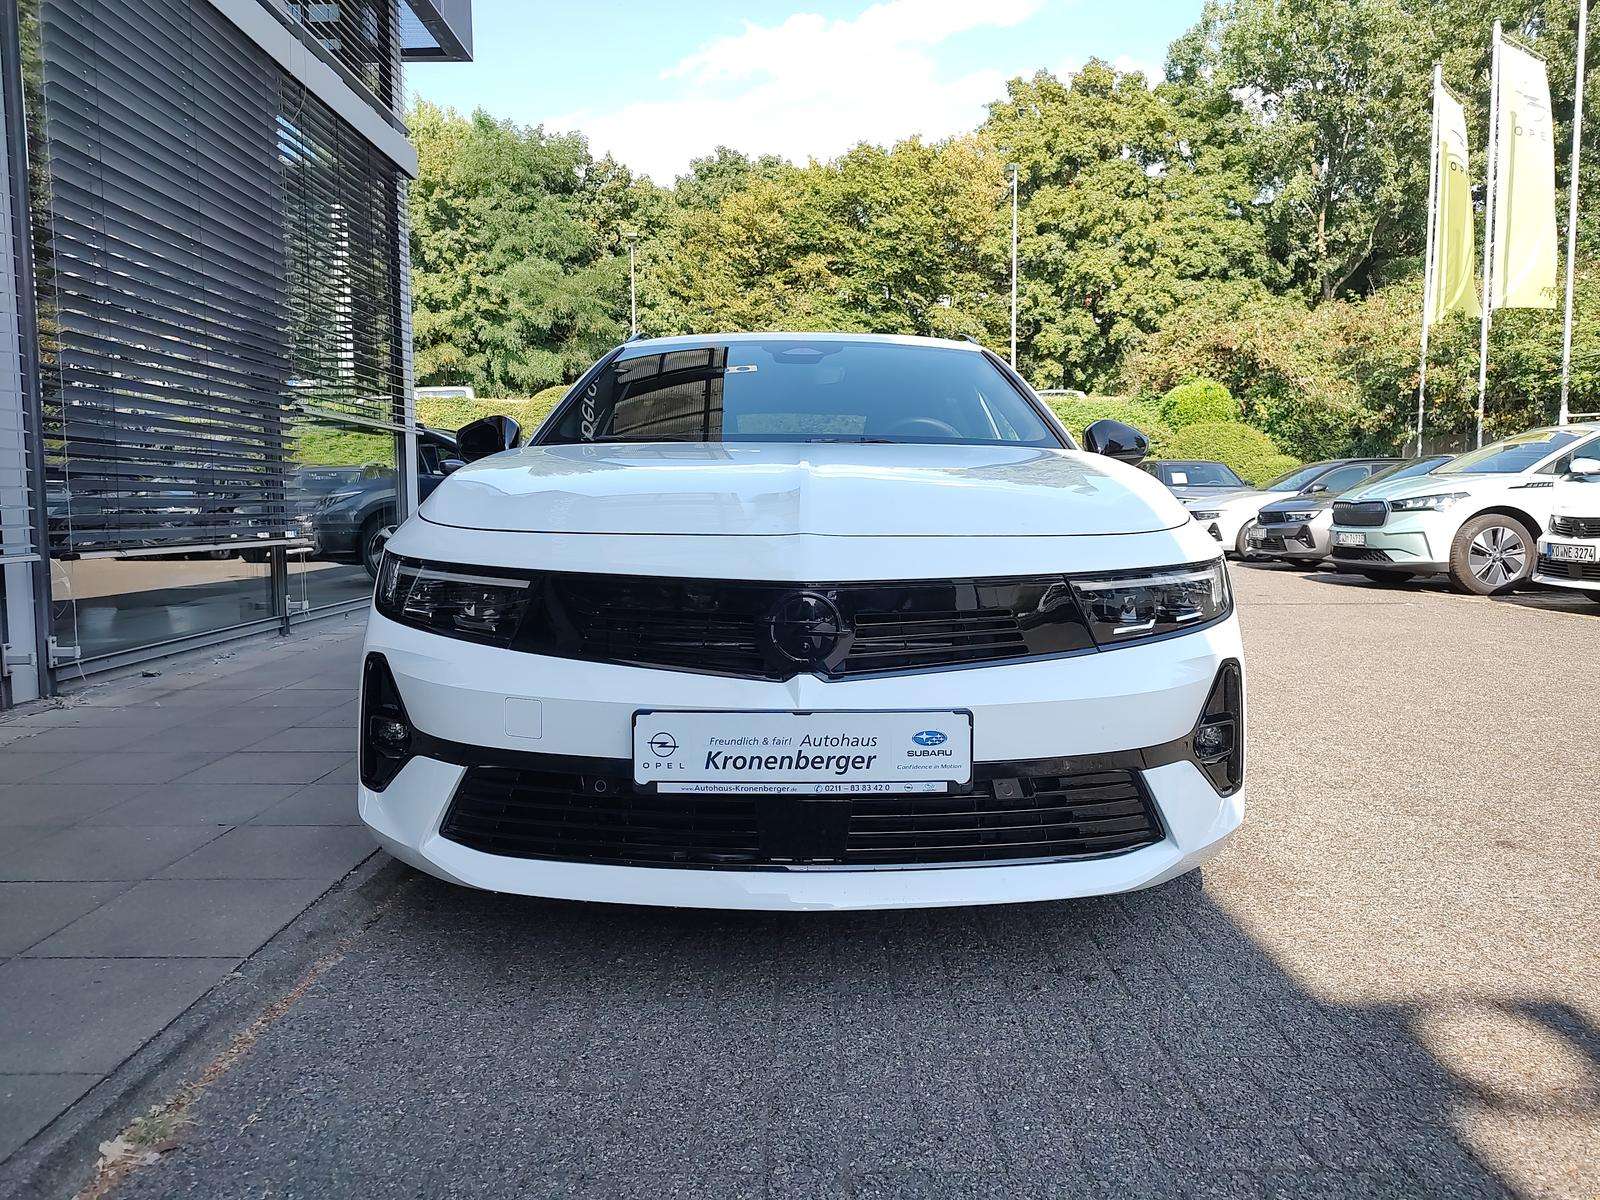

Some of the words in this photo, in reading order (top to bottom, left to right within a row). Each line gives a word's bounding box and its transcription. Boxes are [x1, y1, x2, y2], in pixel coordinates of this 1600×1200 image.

[1552, 546, 1559, 557] KO
[1564, 546, 1572, 558] NE
[1574, 548, 1593, 559] 3274
[709, 737, 760, 746] Freundlich
[762, 737, 770, 746] &
[772, 737, 793, 746] fair!
[799, 733, 878, 747] Autohaus
[907, 749, 952, 757] SUBARU
[705, 750, 877, 775] Kronenberger
[824, 784, 842, 792] 0211
[850, 784, 860, 792] 83
[861, 784, 871, 792] 83
[873, 784, 884, 792] 42
